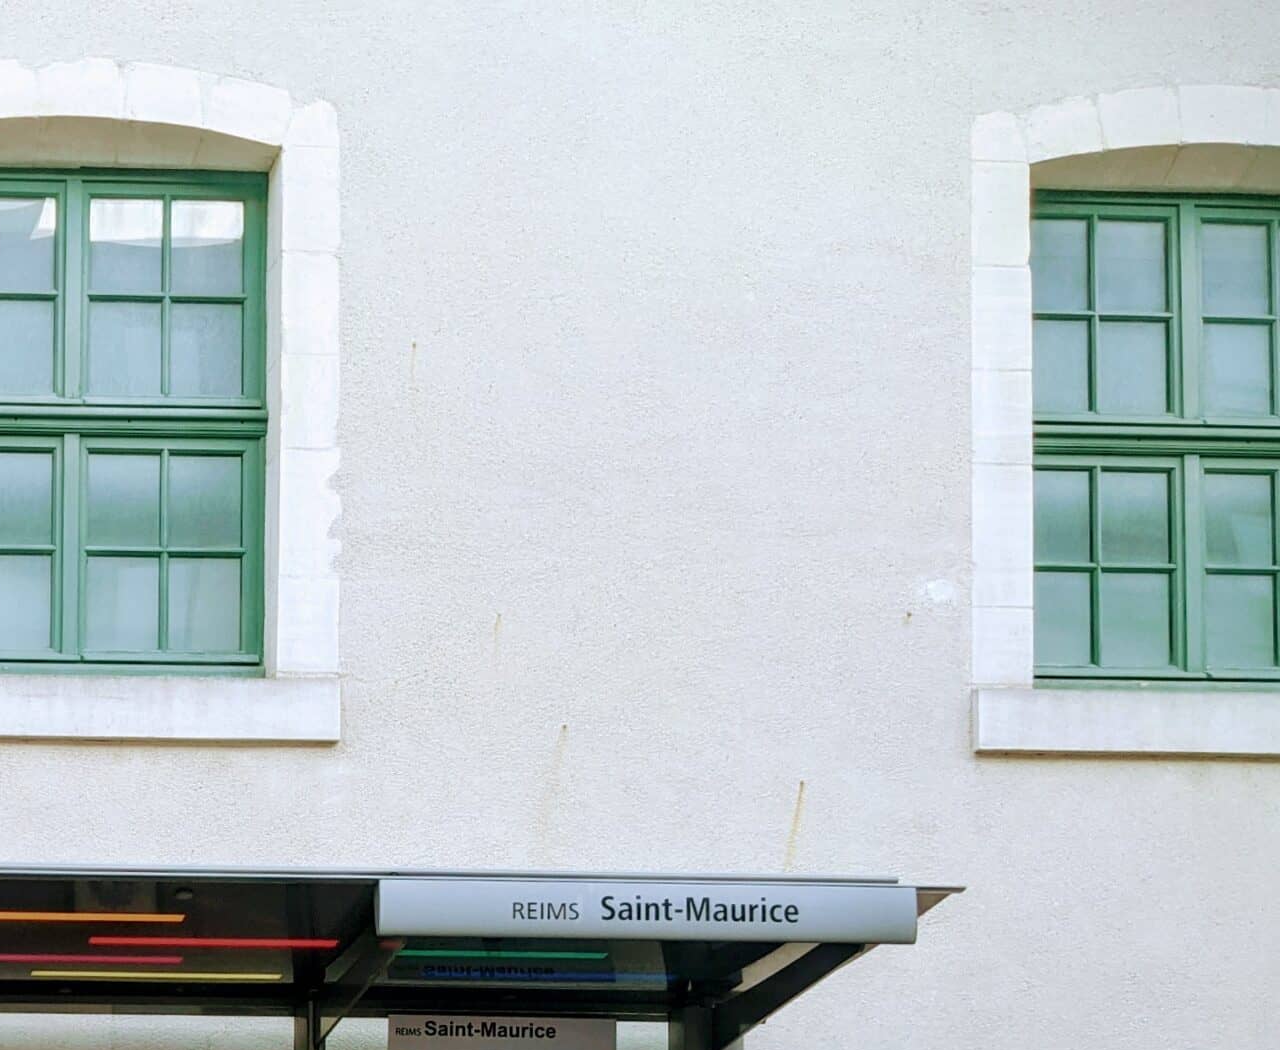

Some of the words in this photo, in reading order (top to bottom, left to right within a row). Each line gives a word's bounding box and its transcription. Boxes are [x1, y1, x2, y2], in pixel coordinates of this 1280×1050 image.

[512, 901, 580, 921] REIMS
[600, 895, 800, 923] Saint-Maurice
[395, 1027, 422, 1036] REIMS
[424, 1020, 556, 1038] Saint-Maurice
